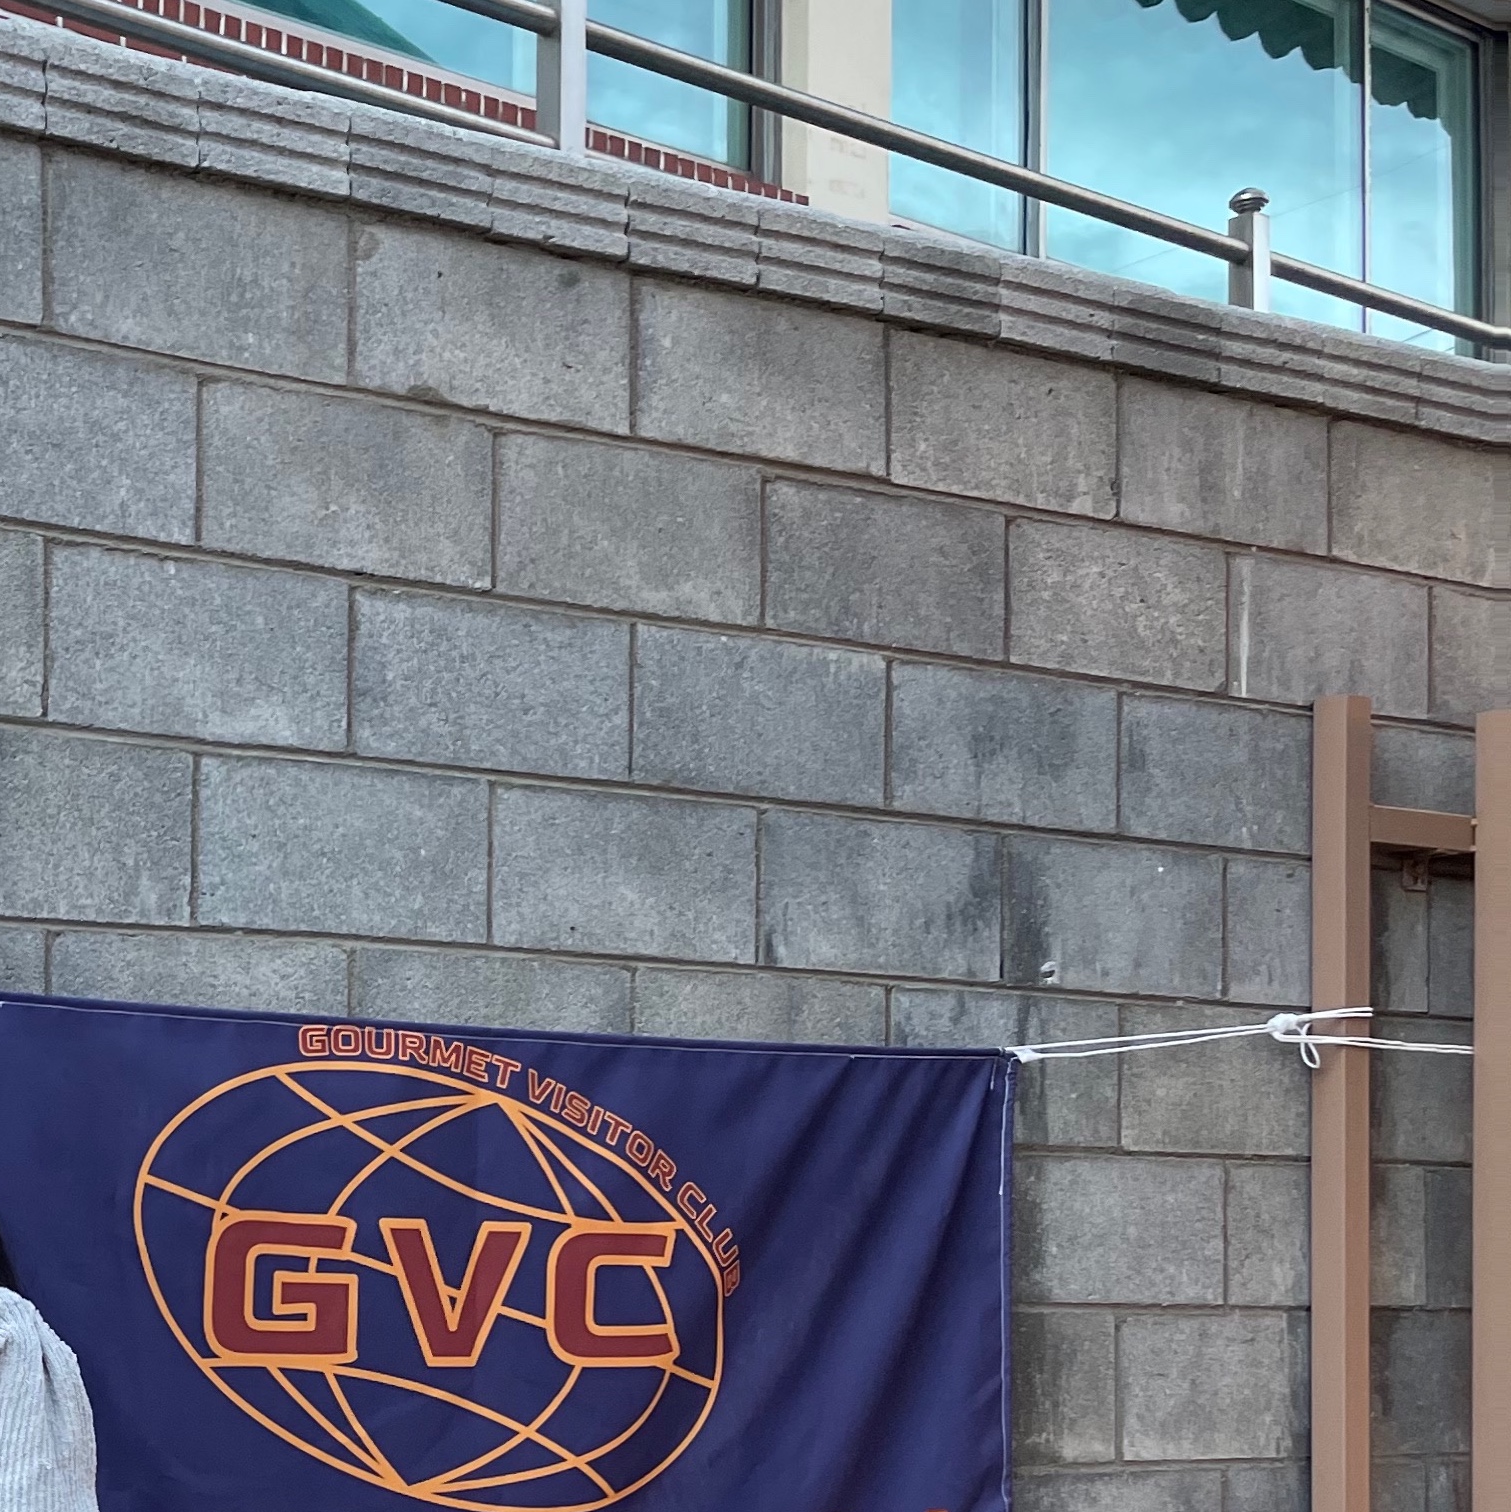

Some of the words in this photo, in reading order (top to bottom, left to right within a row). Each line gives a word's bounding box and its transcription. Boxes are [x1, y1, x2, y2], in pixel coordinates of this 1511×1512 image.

[299, 1024, 521, 1089] GOURMET
[526, 1068, 678, 1192] VISITOR
[676, 1181, 742, 1297] CLUB
[204, 1212, 681, 1369] GVC
